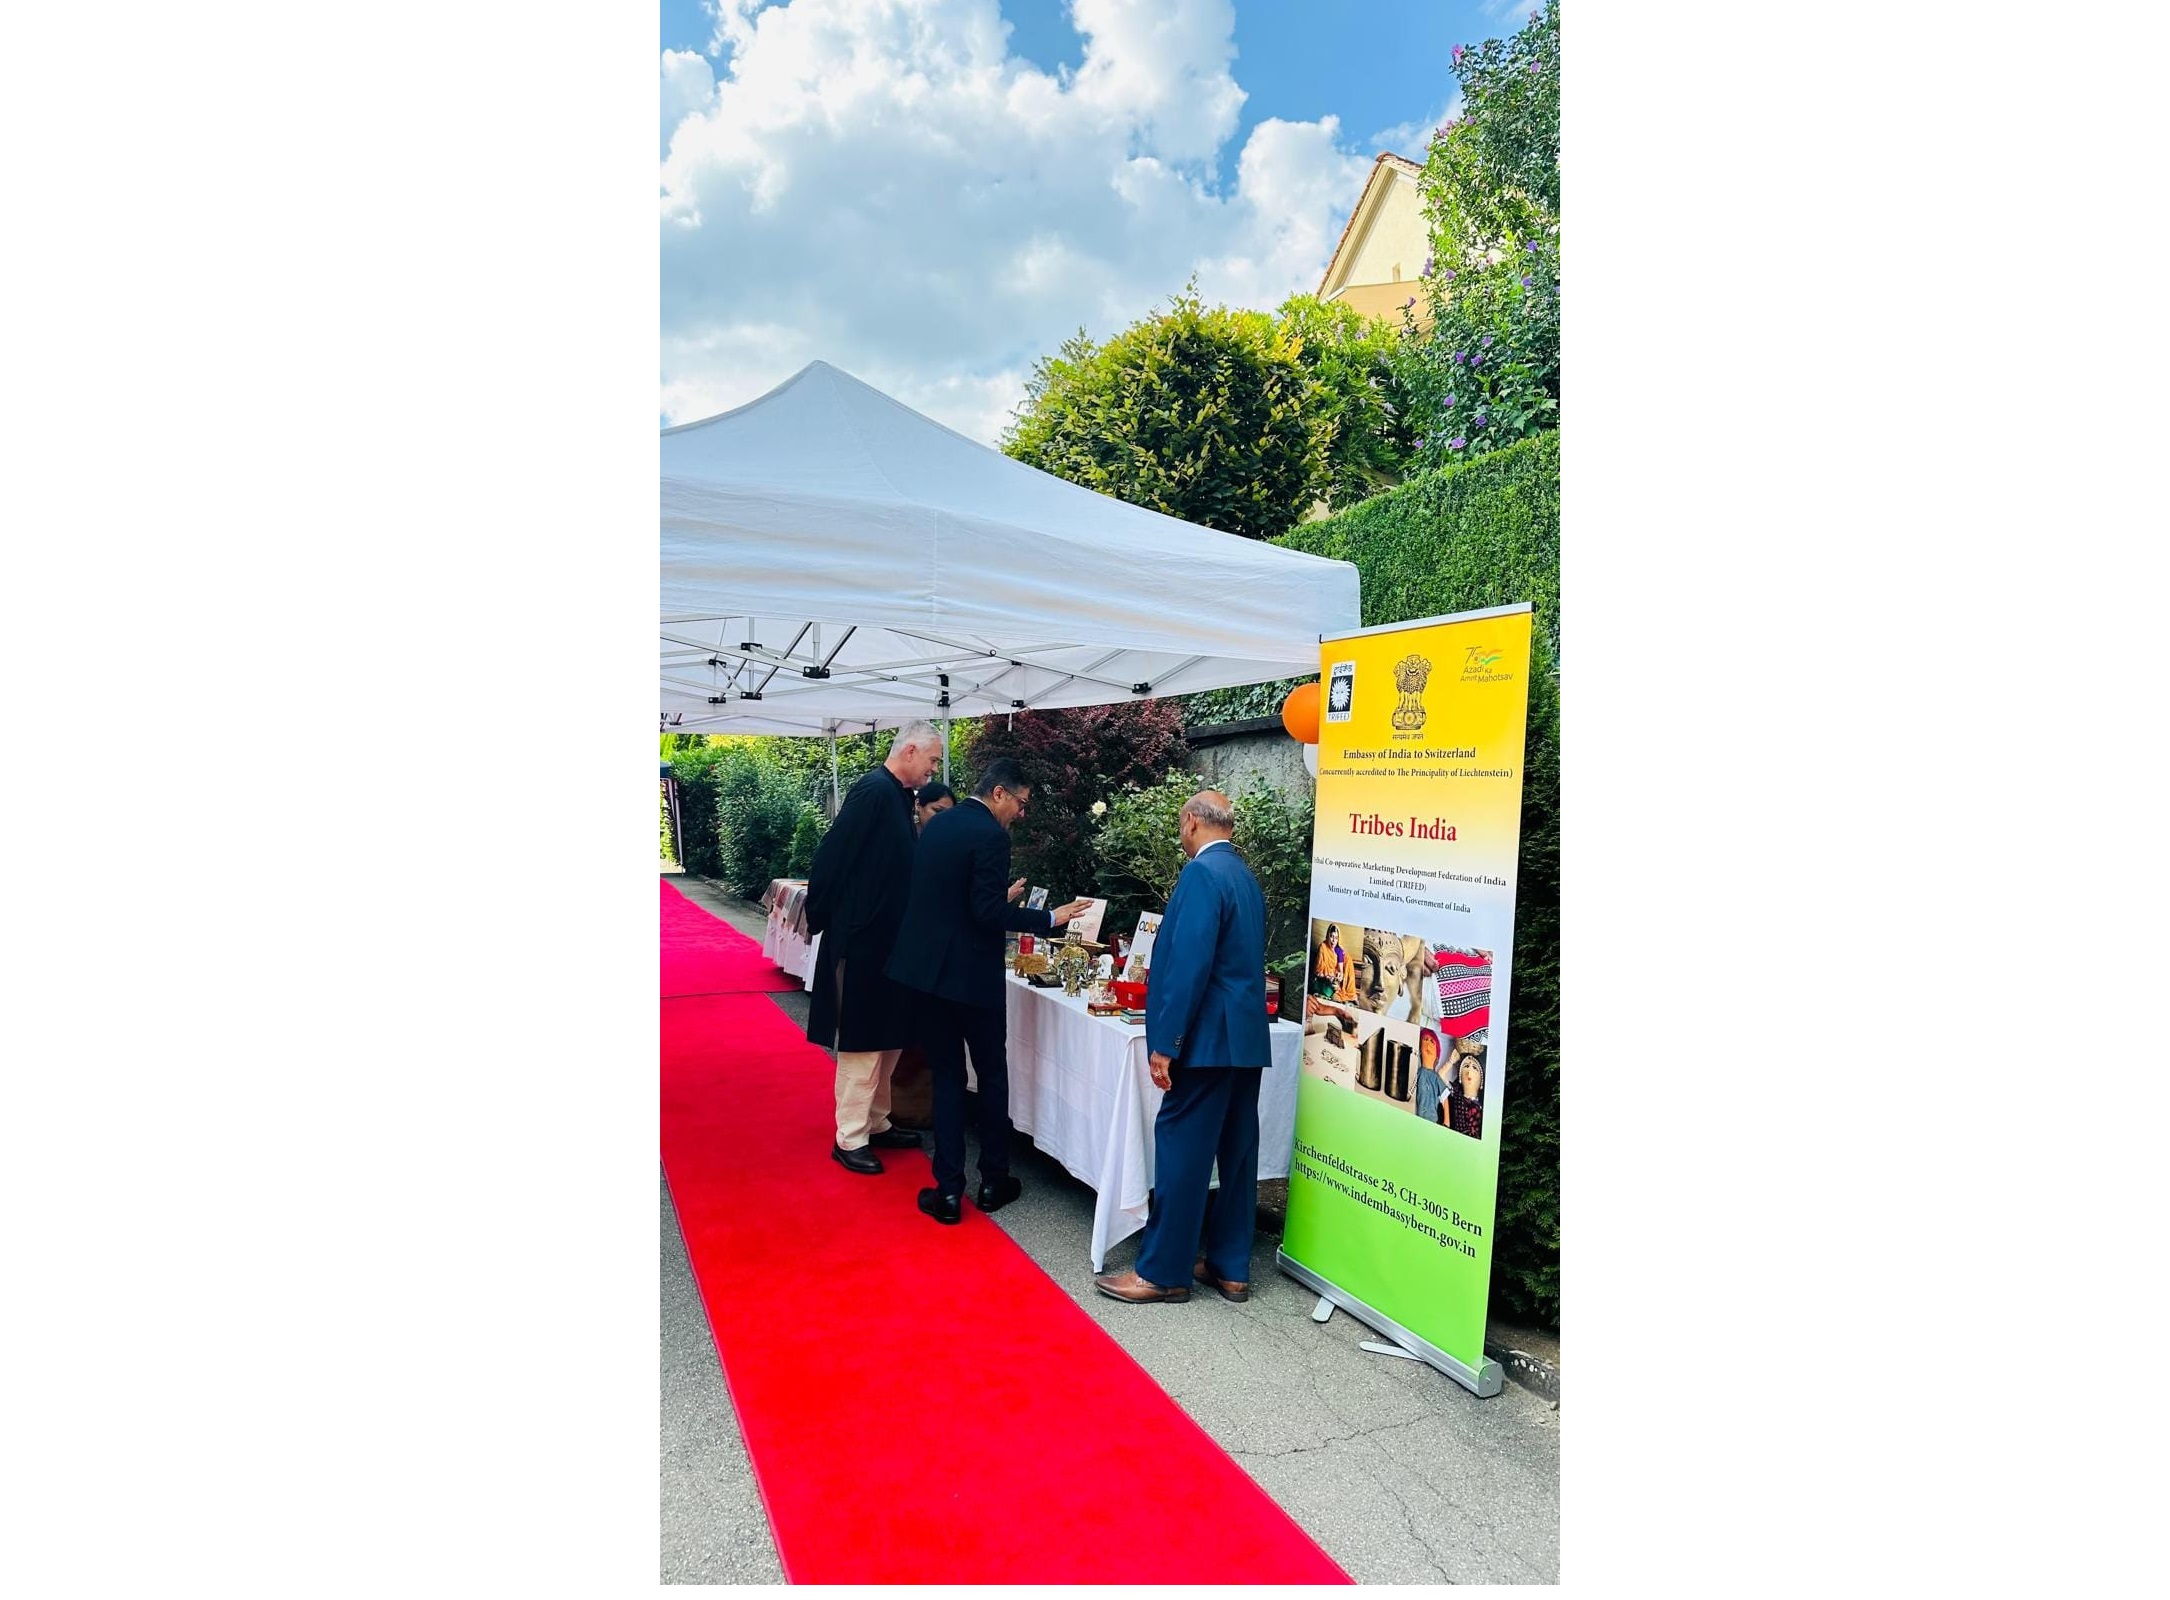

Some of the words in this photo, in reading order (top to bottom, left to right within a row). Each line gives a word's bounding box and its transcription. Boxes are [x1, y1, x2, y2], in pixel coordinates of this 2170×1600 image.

[1463, 664, 1484, 674] Azadi
[1478, 673, 1514, 683] Mahotsav
[1343, 749, 1376, 761] Embassy
[1378, 749, 1387, 759] of
[1388, 749, 1411, 759] India
[1414, 750, 1423, 759] to
[1425, 747, 1476, 759] Switzerland
[1356, 768, 1387, 776] accredited
[1398, 768, 1410, 776] The
[1411, 768, 1448, 779] Principality
[1450, 768, 1458, 777] of
[1460, 768, 1513, 778] Liechtenstein)
[1350, 813, 1404, 837] Tribes
[1409, 817, 1457, 841] India
[1325, 858, 1361, 869] Co-operative
[1362, 862, 1395, 874] Marketing
[1396, 866, 1437, 878] Development
[1438, 870, 1473, 882] Federation
[1474, 875, 1483, 884] of
[1484, 876, 1506, 886] India
[1369, 876, 1395, 887] Limited
[1396, 880, 1427, 893] (TRIFED)
[1328, 884, 1352, 896] Ministry
[1361, 889, 1380, 899] Tribal
[1381, 892, 1405, 904] Affairs,
[1405, 896, 1444, 909] Government
[1445, 902, 1453, 910] of
[1453, 903, 1471, 913] India
[1294, 1138, 1379, 1187] Kirchenfeldstrasse
[1381, 1179, 1397, 1198] 28,
[1399, 1187, 1449, 1221] CH-3005
[1452, 1211, 1483, 1237] Bern
[1295, 1157, 1477, 1259] https://www.indembassybern.gov.in
